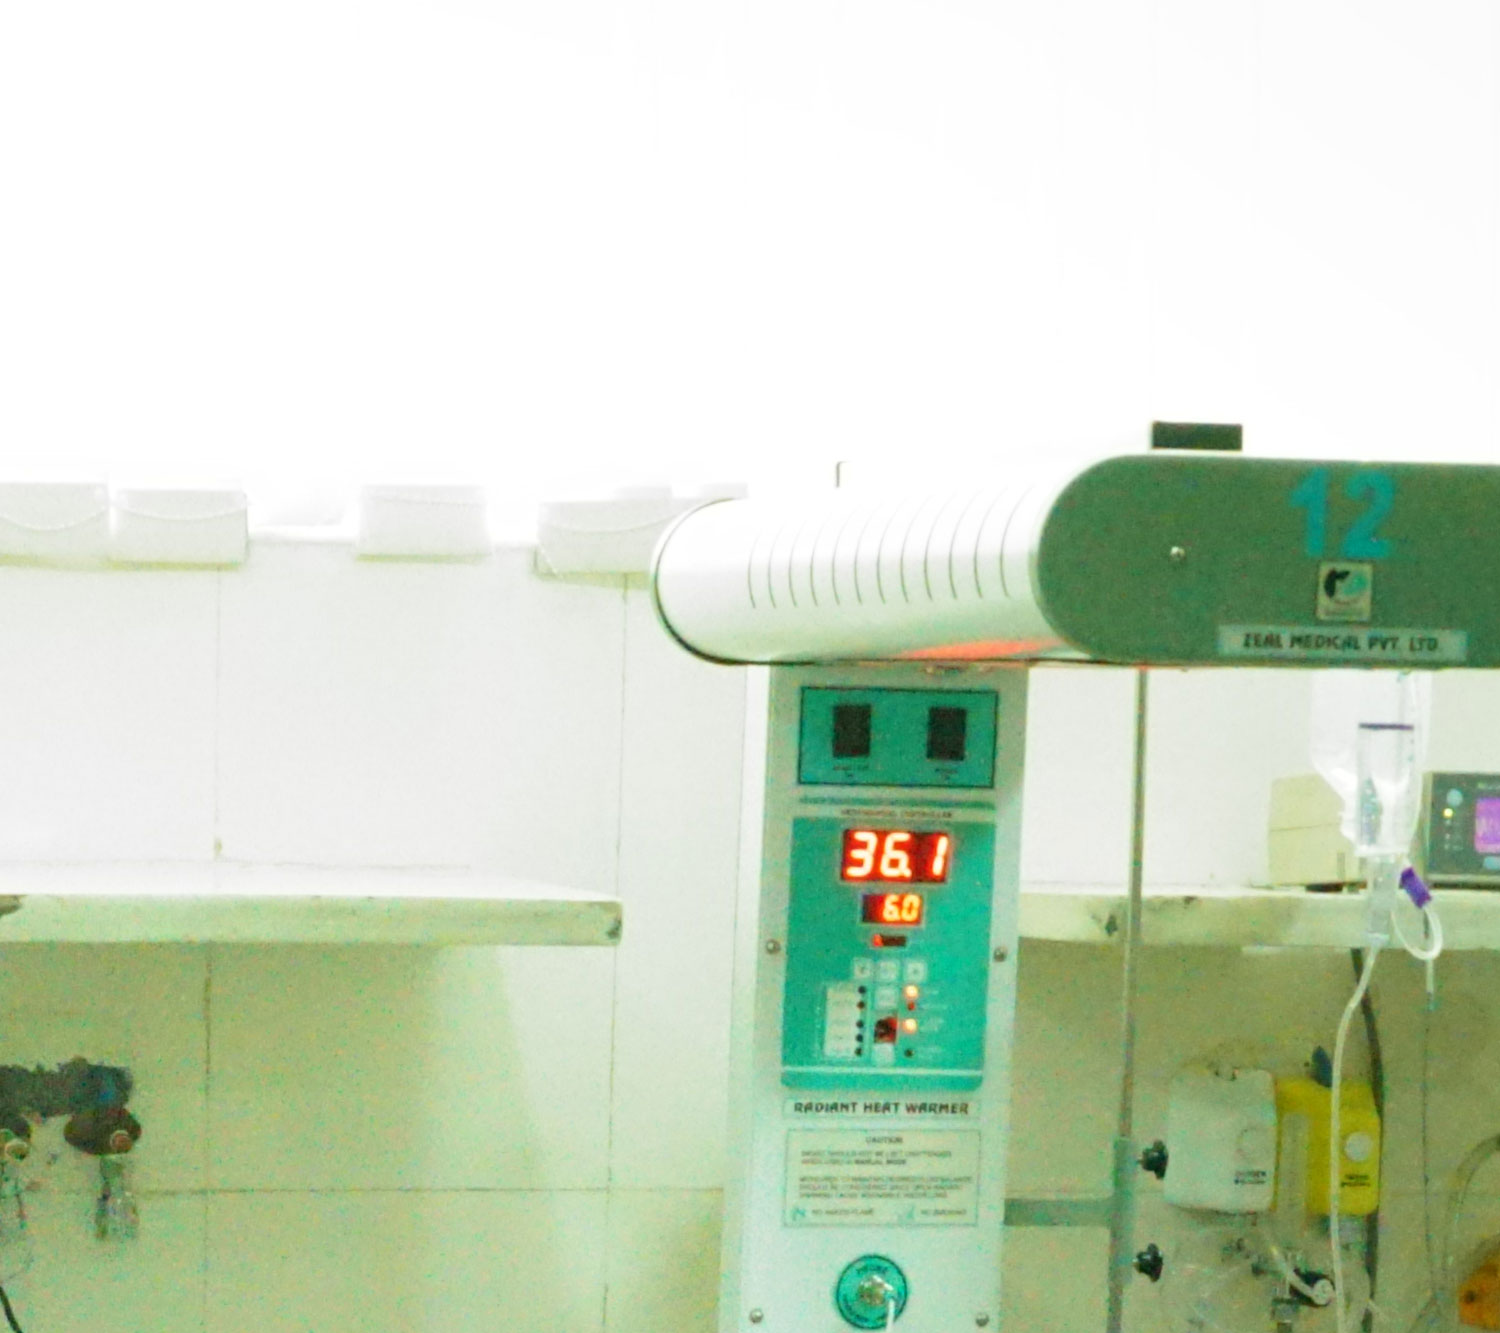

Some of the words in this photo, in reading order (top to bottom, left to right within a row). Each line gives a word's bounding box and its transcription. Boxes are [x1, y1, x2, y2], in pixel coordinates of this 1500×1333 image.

[1290, 467, 1395, 558] 12
[1244, 632, 1283, 649] ZEAL
[1290, 633, 1360, 650] MEDICAL
[794, 1101, 858, 1114] RADIANT
[863, 1101, 899, 1114] HEAT
[905, 1101, 969, 1115] WARMER
